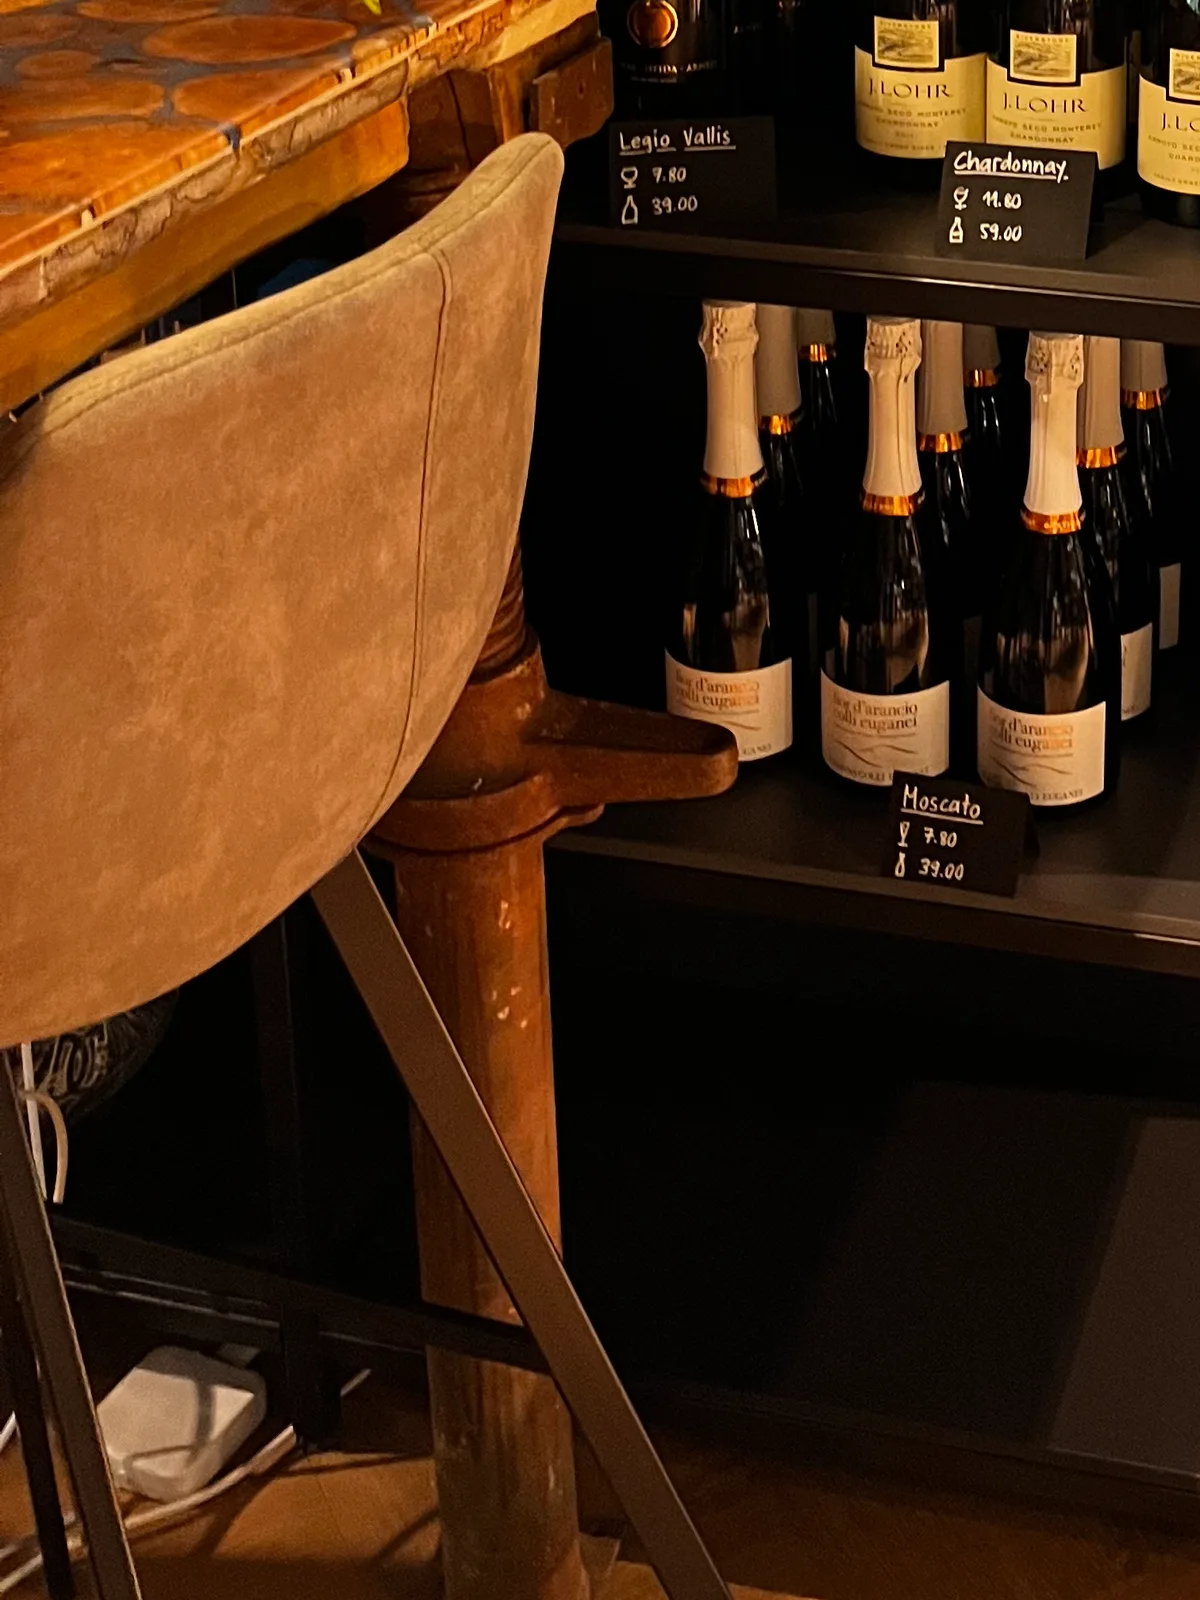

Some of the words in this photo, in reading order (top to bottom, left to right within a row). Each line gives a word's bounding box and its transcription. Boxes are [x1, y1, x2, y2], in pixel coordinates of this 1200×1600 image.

[619, 129, 670, 154] Legio
[684, 125, 731, 146] Vallis
[652, 166, 687, 183] 7.80
[652, 195, 698, 215] 39.00
[980, 225, 1022, 242] 59.00
[854, 699, 918, 717] d'arancio
[860, 717, 917, 733] euganei
[902, 786, 981, 820] Moscato
[924, 827, 957, 848] 7.80
[918, 858, 964, 881] 39.00
